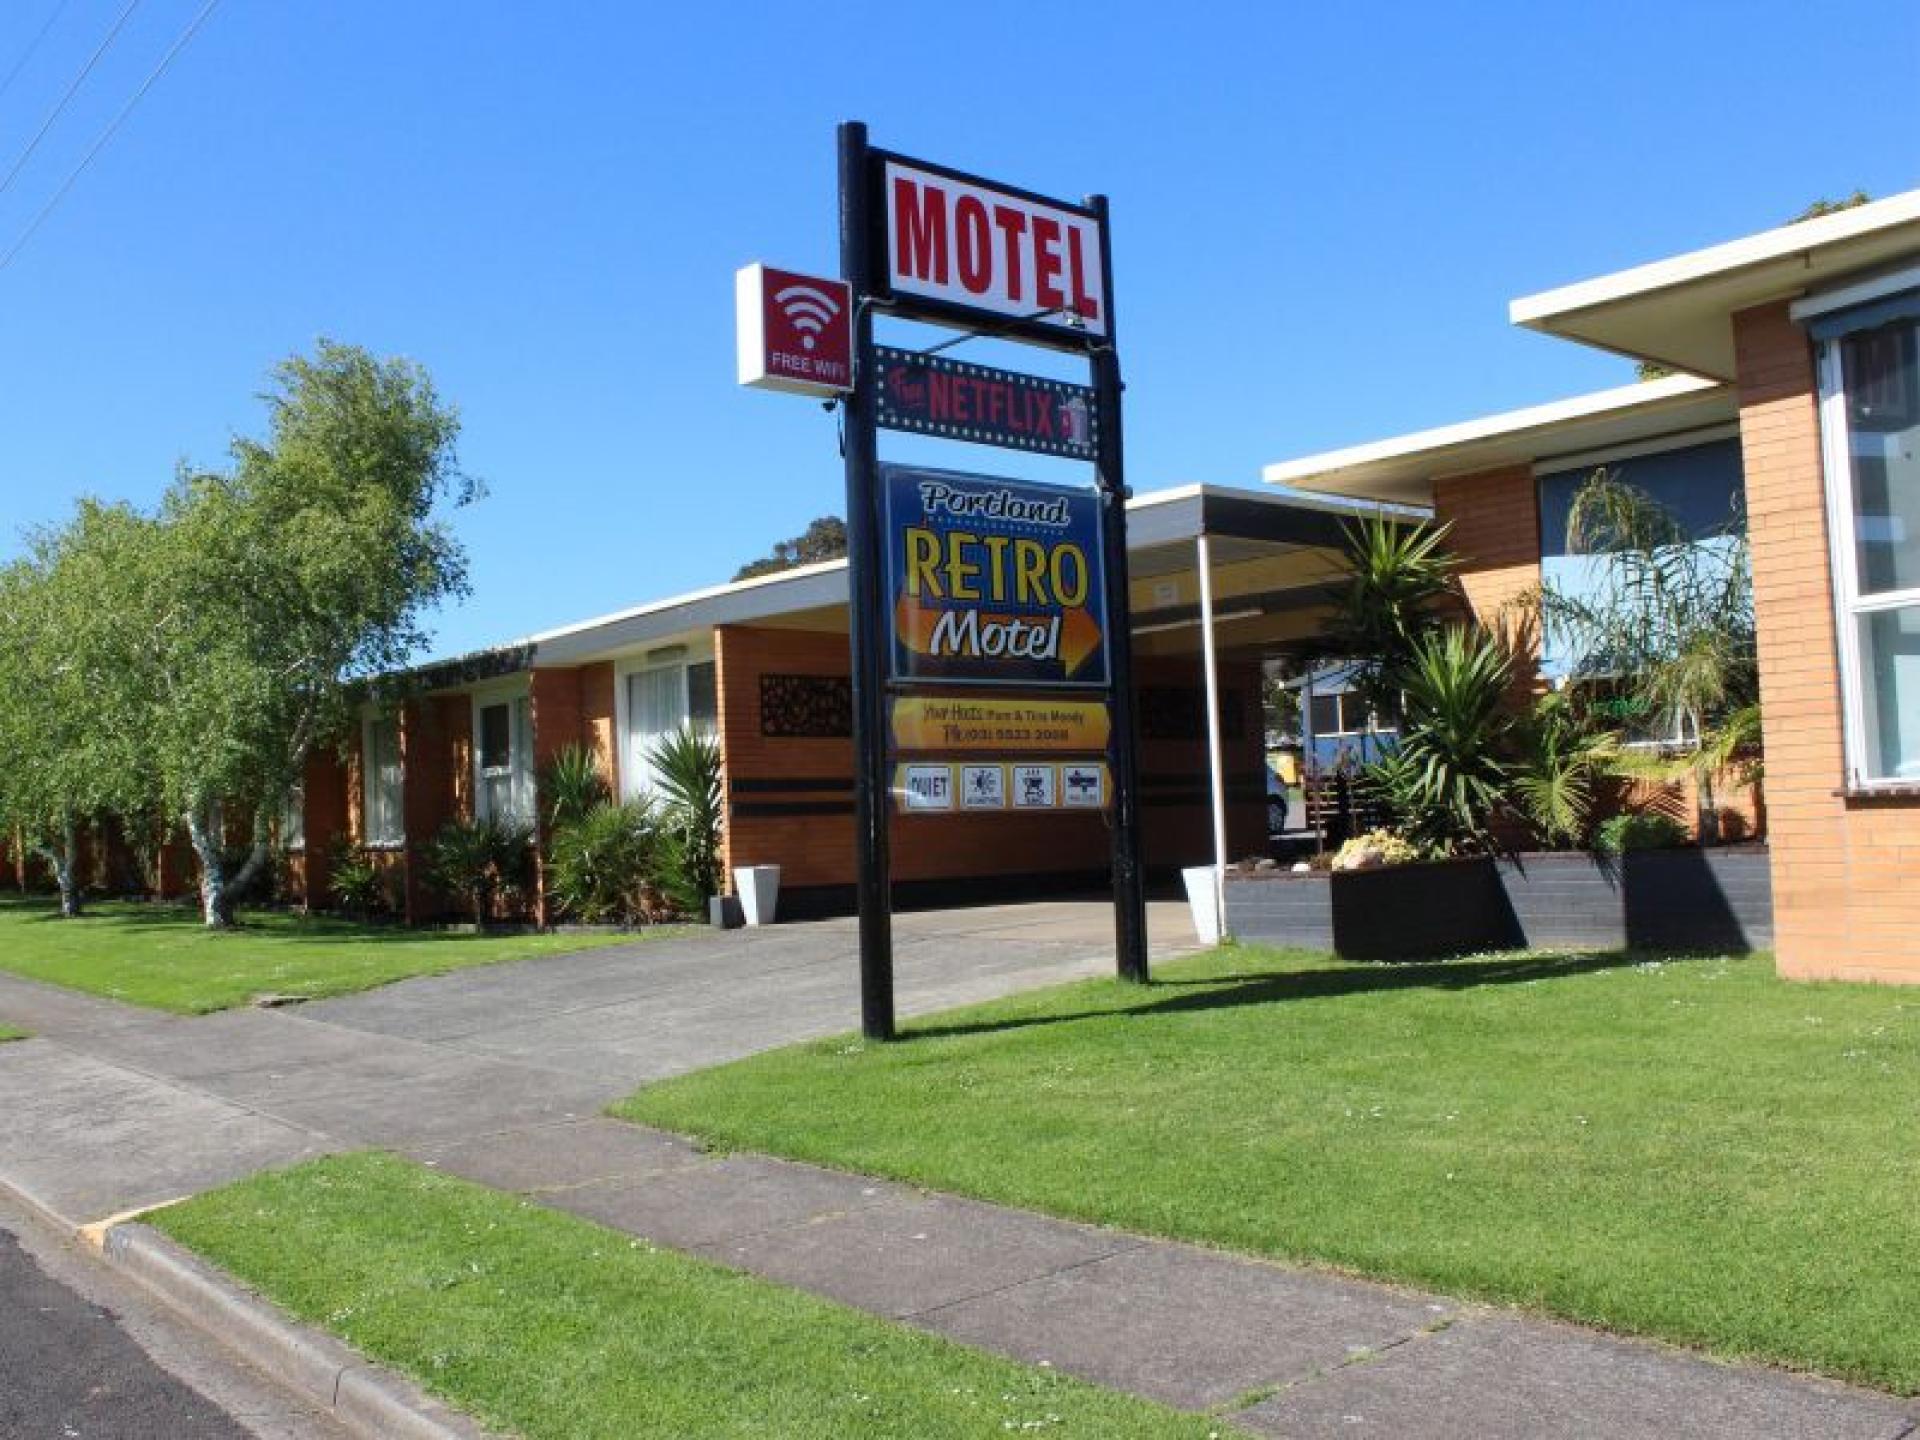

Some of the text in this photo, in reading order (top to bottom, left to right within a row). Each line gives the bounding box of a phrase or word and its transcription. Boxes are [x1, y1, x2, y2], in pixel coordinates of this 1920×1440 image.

[894, 176, 1098, 319] MOTEL
[772, 352, 812, 373] FREE
[929, 370, 1052, 439] NETFLIX
[918, 480, 1070, 528] Portland
[906, 526, 1088, 607] RETRO
[929, 608, 1061, 660] Motel
